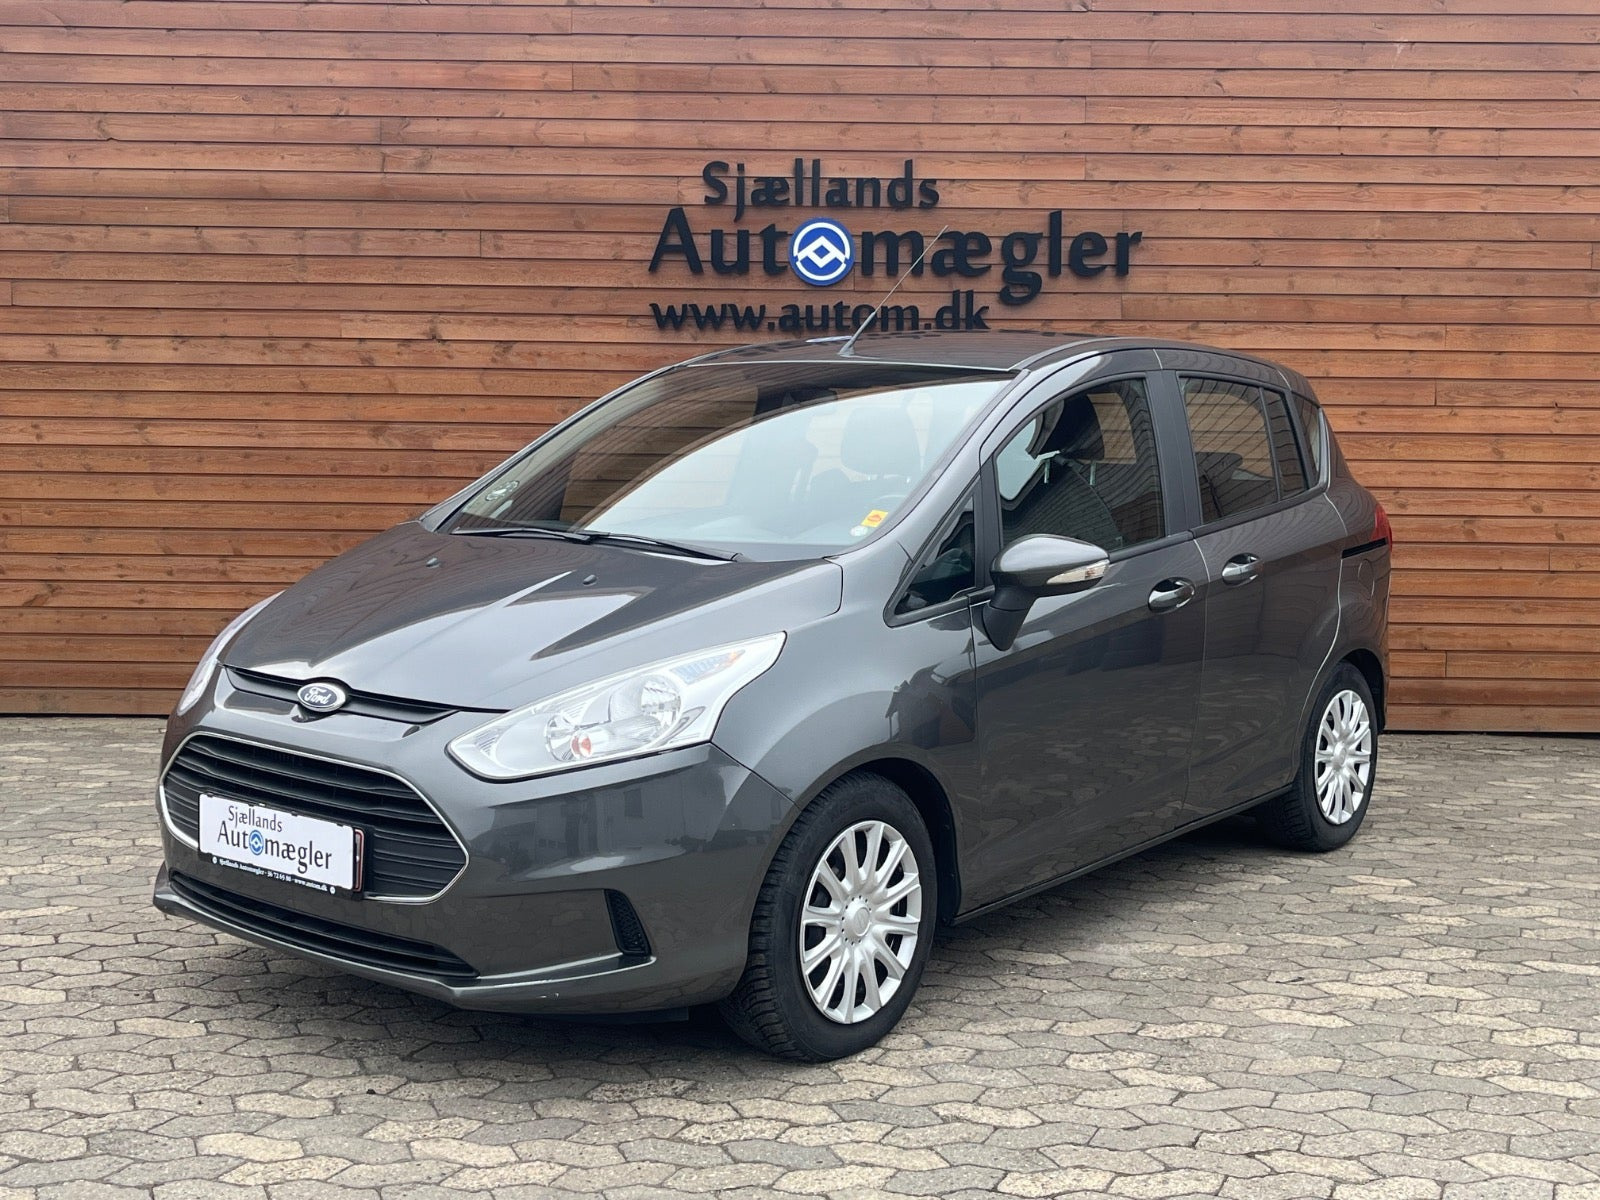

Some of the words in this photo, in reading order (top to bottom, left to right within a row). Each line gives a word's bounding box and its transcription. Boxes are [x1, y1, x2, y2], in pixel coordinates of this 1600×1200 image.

[702, 157, 940, 222] Sjællands
[648, 207, 1143, 305] Automægler
[649, 290, 990, 332] www.autom.dk
[304, 687, 331, 704] Ford
[229, 806, 283, 832] Sjællands
[218, 821, 332, 874] Automægler
